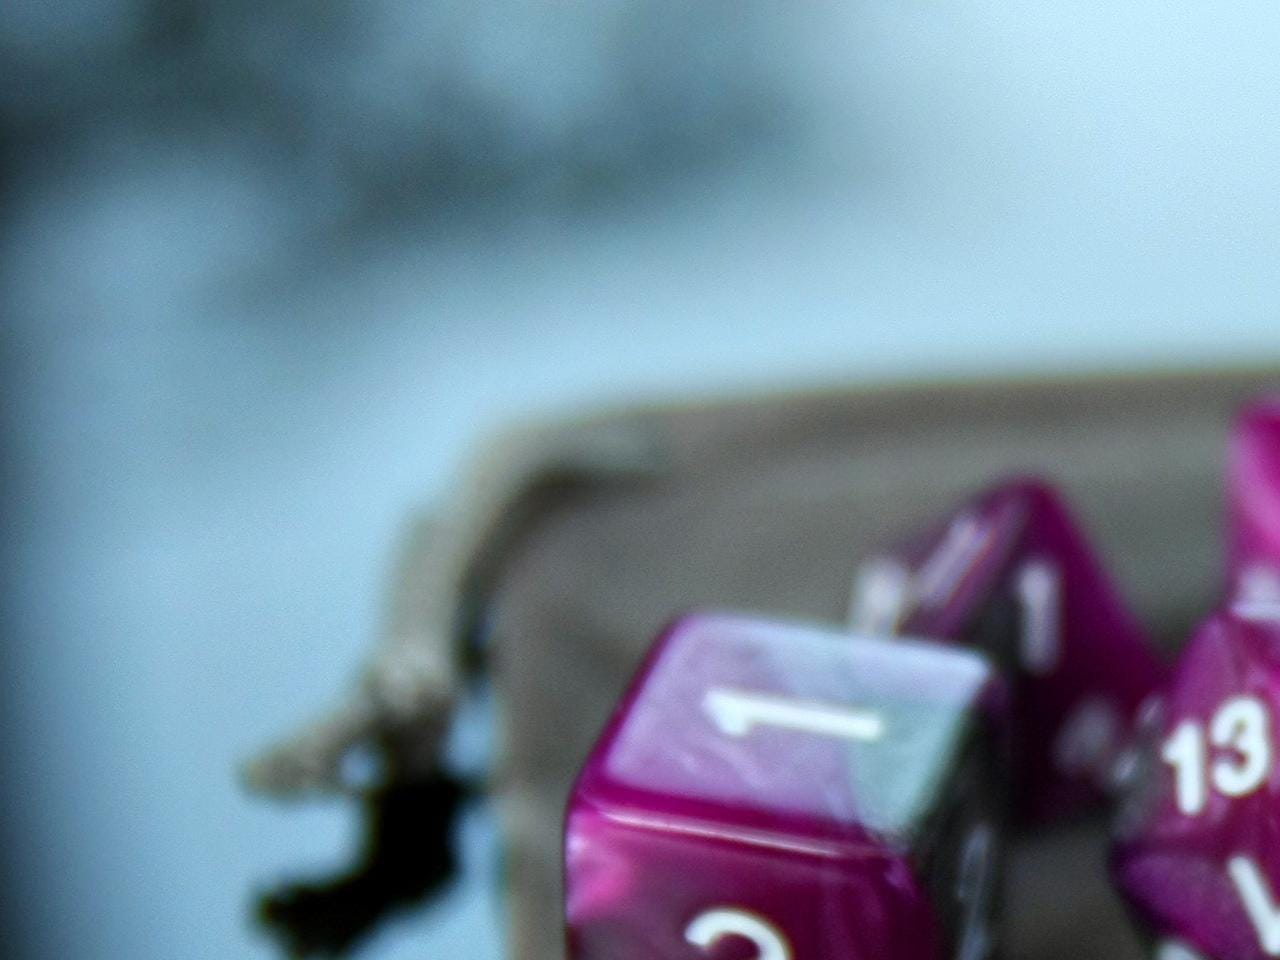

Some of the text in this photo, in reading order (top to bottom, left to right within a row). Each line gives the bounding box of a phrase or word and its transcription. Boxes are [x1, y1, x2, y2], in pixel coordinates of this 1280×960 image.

[1016, 560, 1061, 673] 1
[704, 688, 885, 740] 1
[1162, 696, 1270, 815] 13
